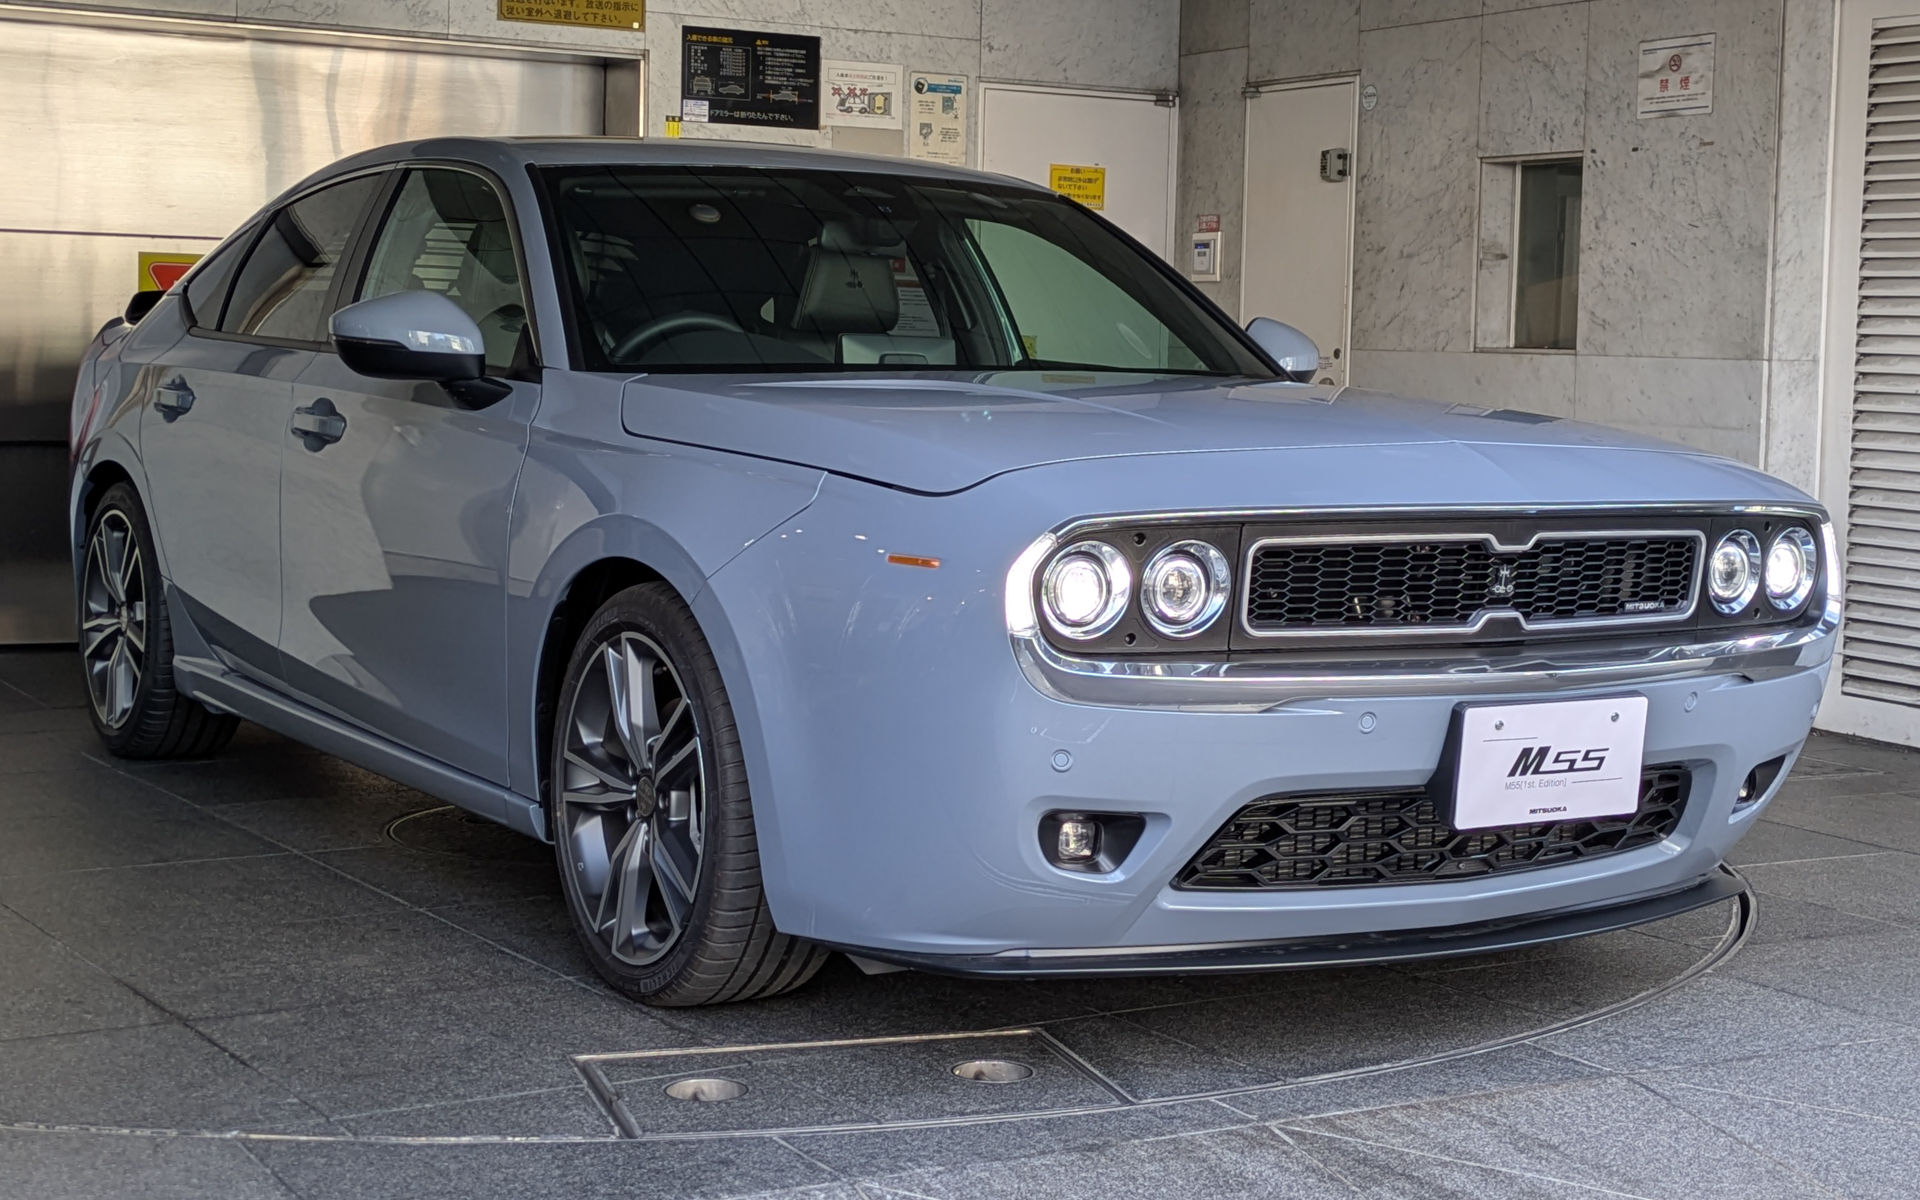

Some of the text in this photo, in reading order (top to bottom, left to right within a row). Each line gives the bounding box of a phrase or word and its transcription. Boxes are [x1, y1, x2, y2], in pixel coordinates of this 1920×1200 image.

[505, 5, 622, 24] 従い室外へ退避して下さい。
[1625, 600, 1665, 611] MITSUOKA
[1529, 806, 1568, 815] MITSUOKA
